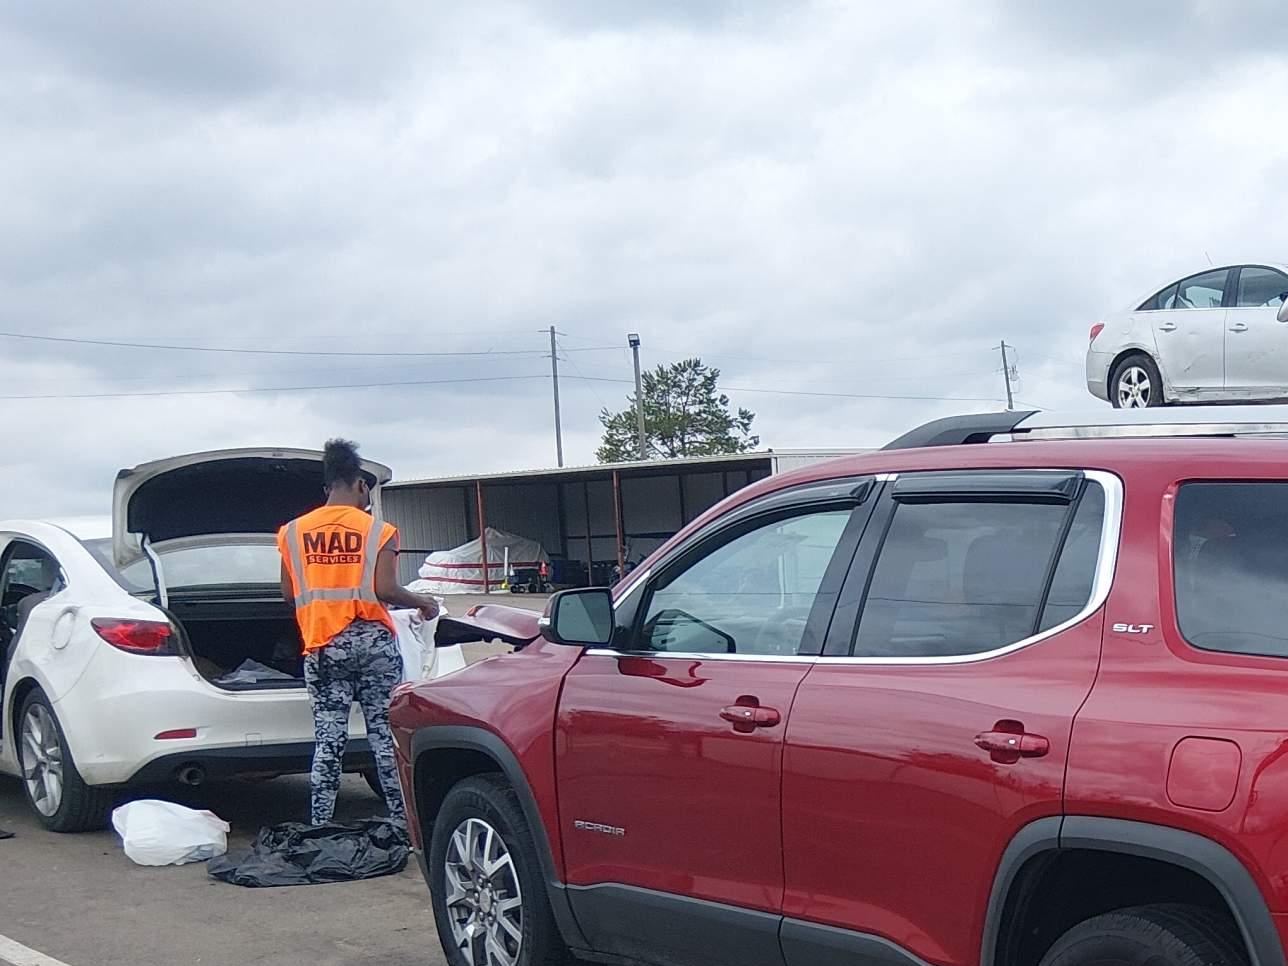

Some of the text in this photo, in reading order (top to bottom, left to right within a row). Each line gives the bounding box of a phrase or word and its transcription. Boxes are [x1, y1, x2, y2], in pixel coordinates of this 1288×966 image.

[303, 531, 363, 554] MAD
[308, 555, 360, 564] SERVICES
[1112, 623, 1155, 634] SLT
[574, 820, 626, 837] ACADIA
